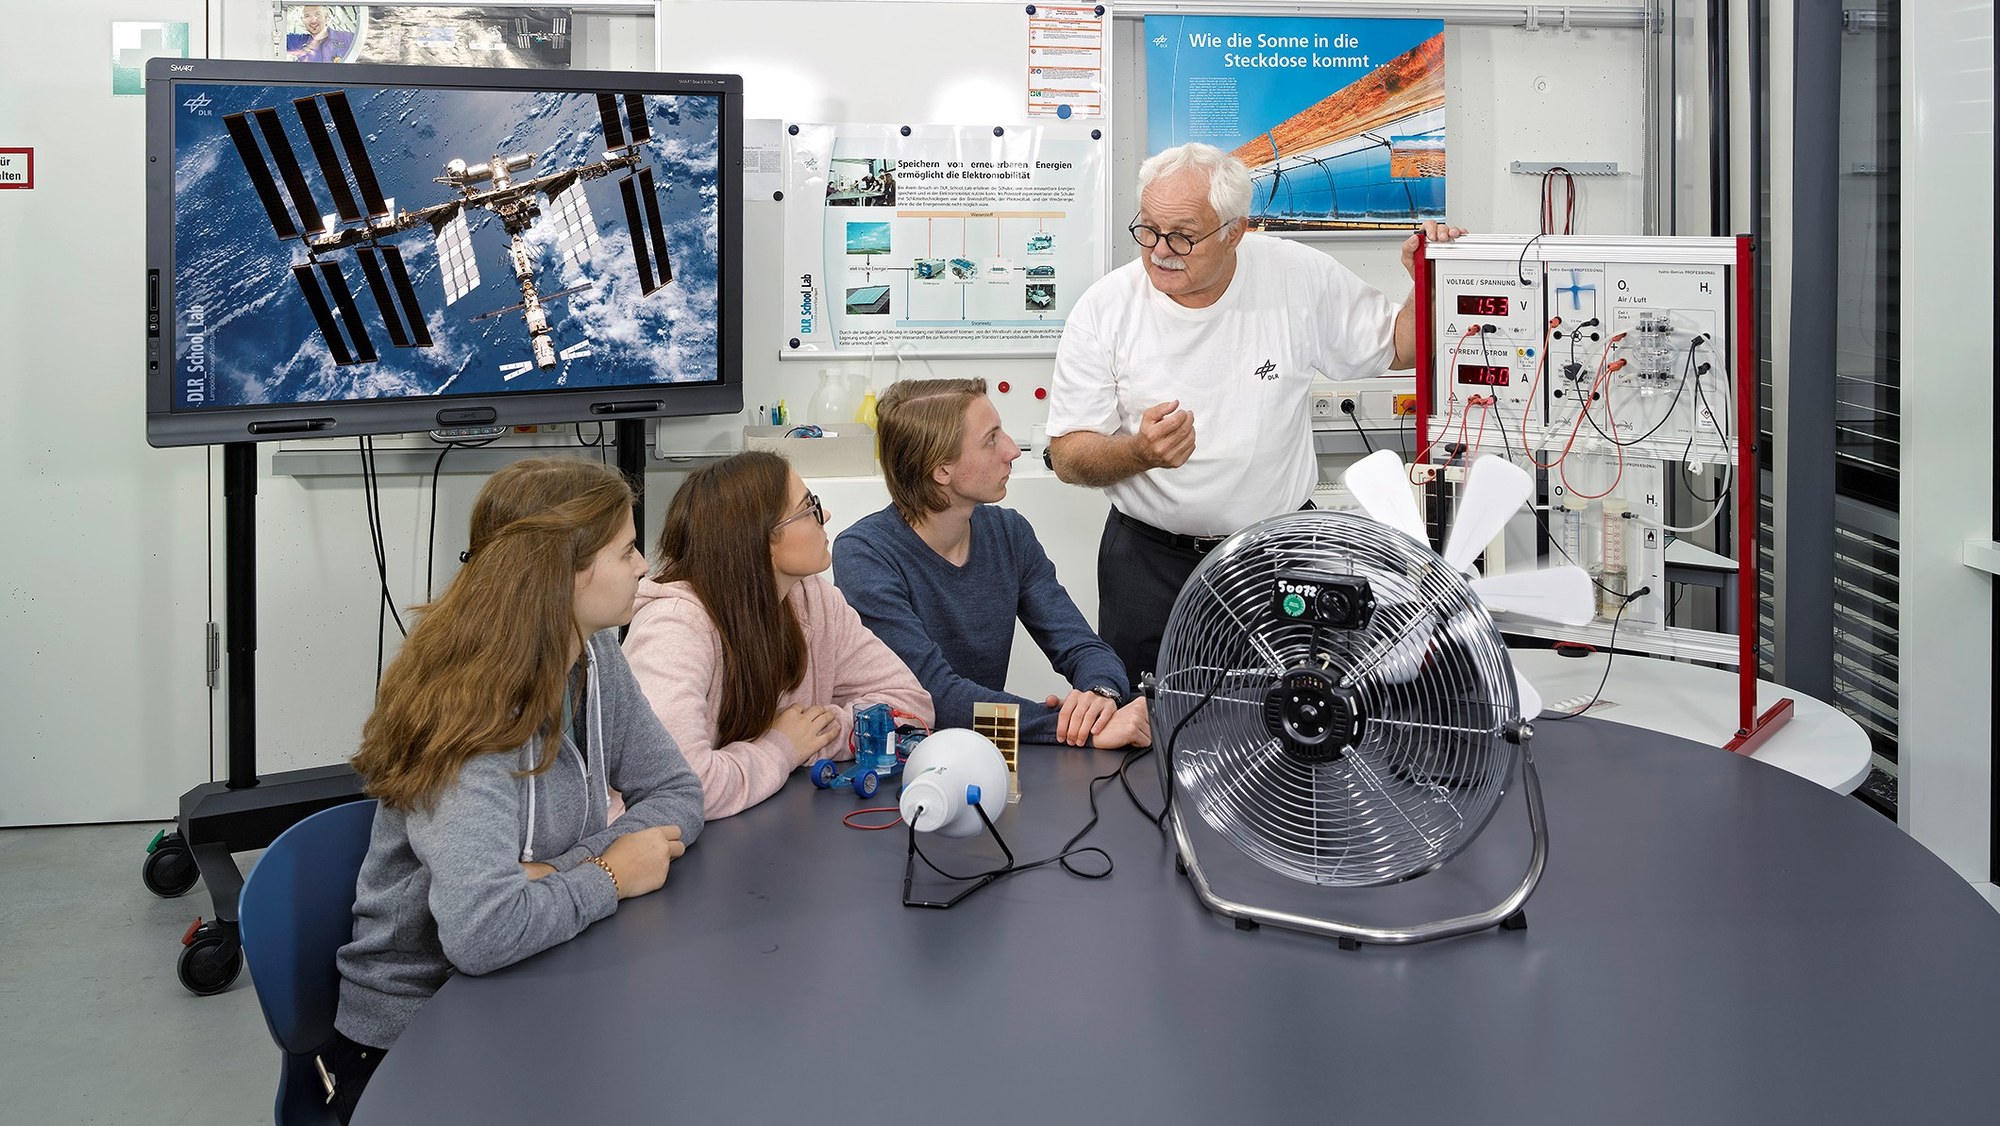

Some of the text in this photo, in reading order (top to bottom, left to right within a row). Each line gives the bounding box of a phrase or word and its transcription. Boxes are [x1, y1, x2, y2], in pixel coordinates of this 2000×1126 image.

[1189, 33, 1359, 49] Wie die Sonne in die
[1224, 52, 1307, 68] Steckdose
[1312, 52, 1370, 68] kommt
[170, 64, 194, 72] SMART
[897, 160, 940, 169] Speichern
[1035, 161, 1073, 171] Energien
[0, 170, 21, 181] lten
[897, 171, 1031, 181] ermöglicht die Elektromobilität
[1446, 278, 1474, 286] VOLTAGE
[1480, 279, 1516, 287] SPANNUNG
[801, 273, 813, 334] DLR_School_Lab
[1519, 300, 1528, 311] V
[186, 304, 207, 402] DLR_School_Lab
[1485, 349, 1508, 357] STROM
[1267, 373, 1280, 381] DLR
[1520, 373, 1529, 383] A
